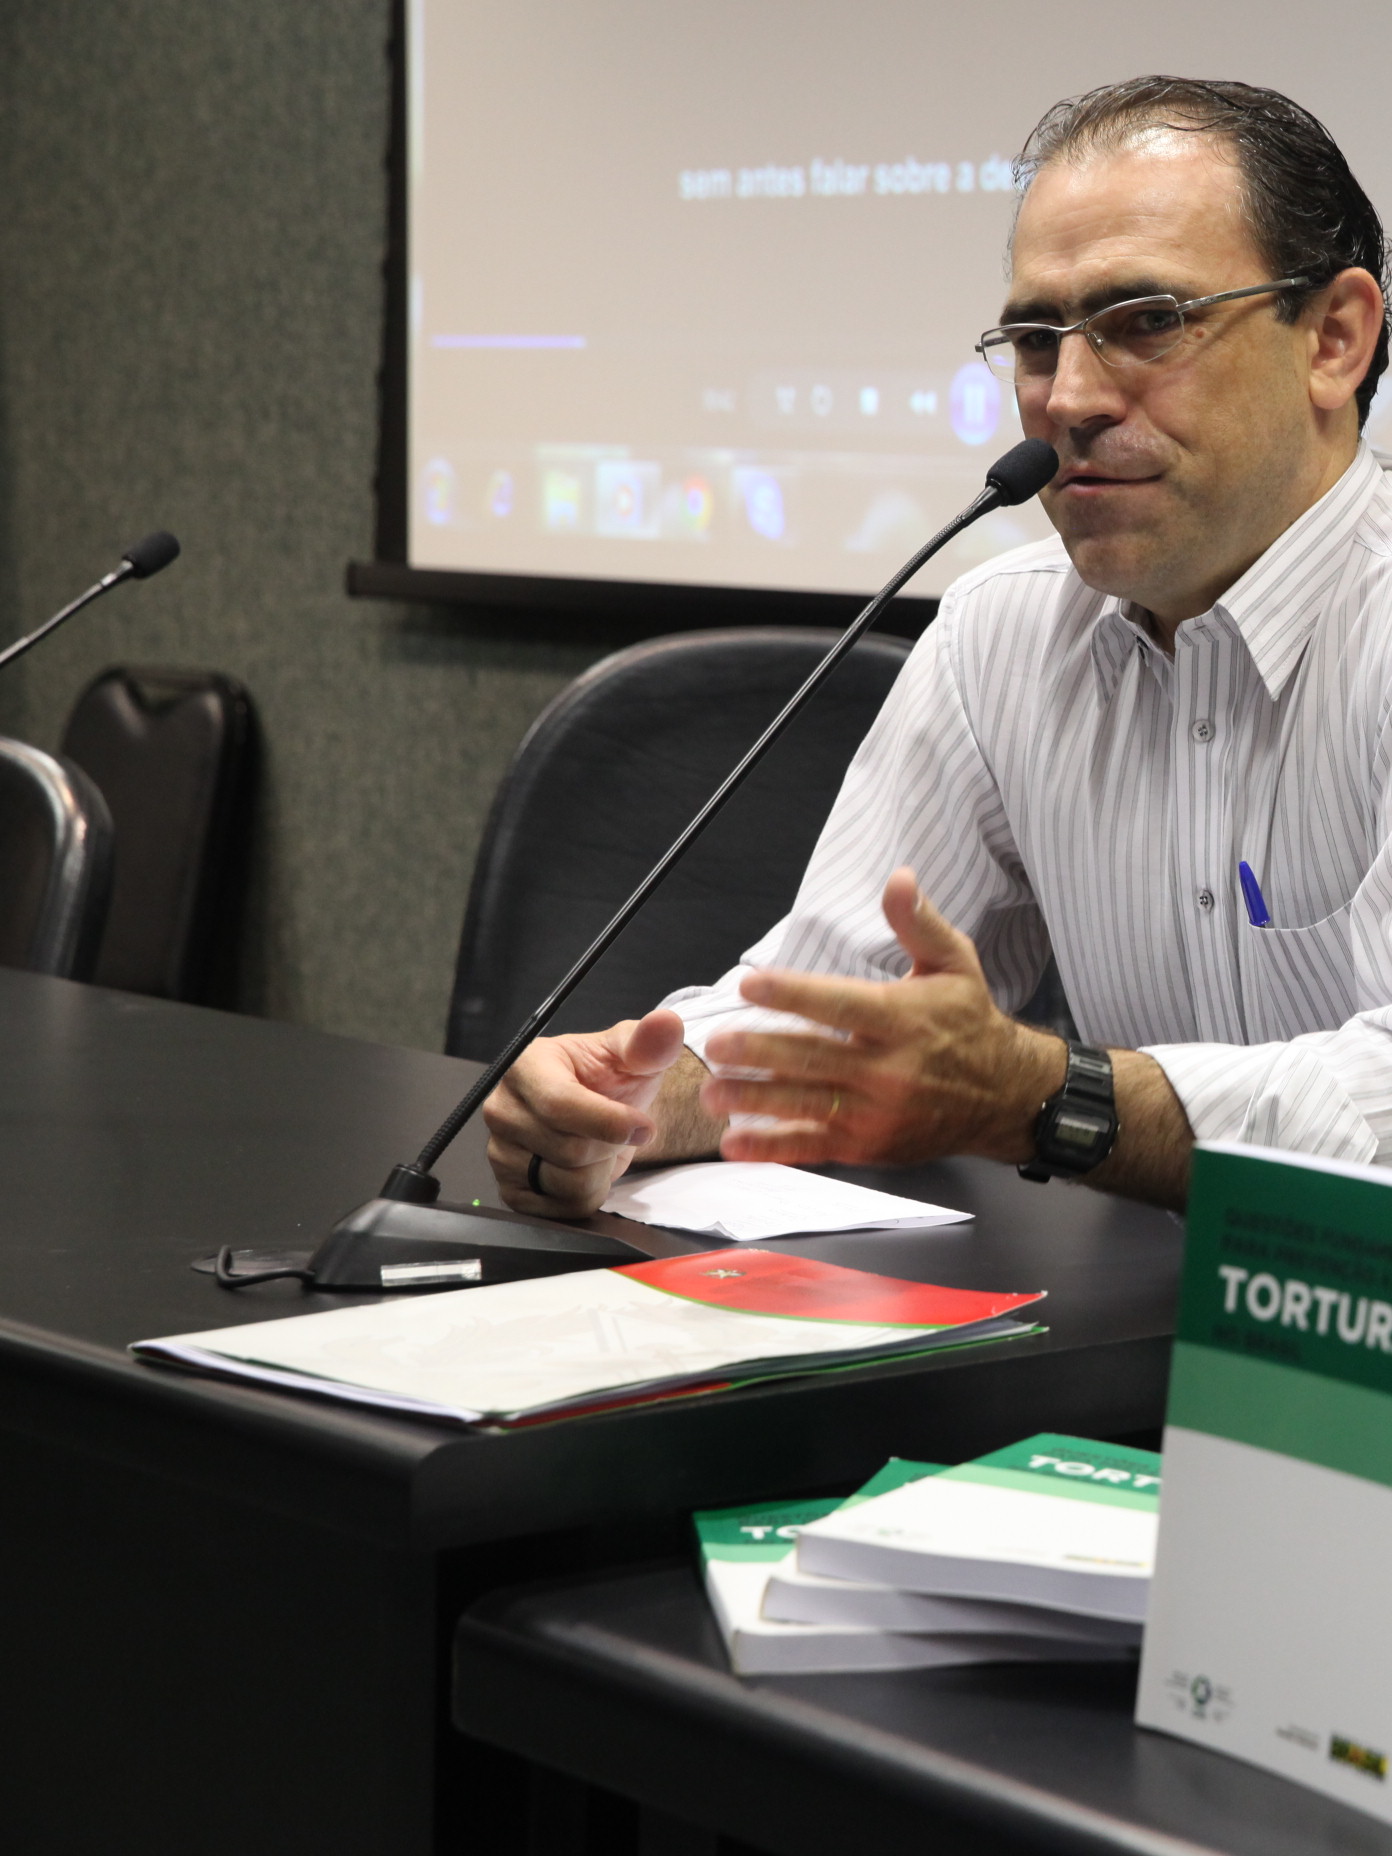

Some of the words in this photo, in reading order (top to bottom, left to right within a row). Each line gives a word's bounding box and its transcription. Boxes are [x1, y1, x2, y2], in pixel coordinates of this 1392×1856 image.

[679, 167, 732, 200] sem
[735, 163, 805, 198] antes
[809, 155, 870, 197] falar
[873, 153, 952, 195] sobre
[955, 160, 976, 193] a
[1028, 1453, 1163, 1488] TORT
